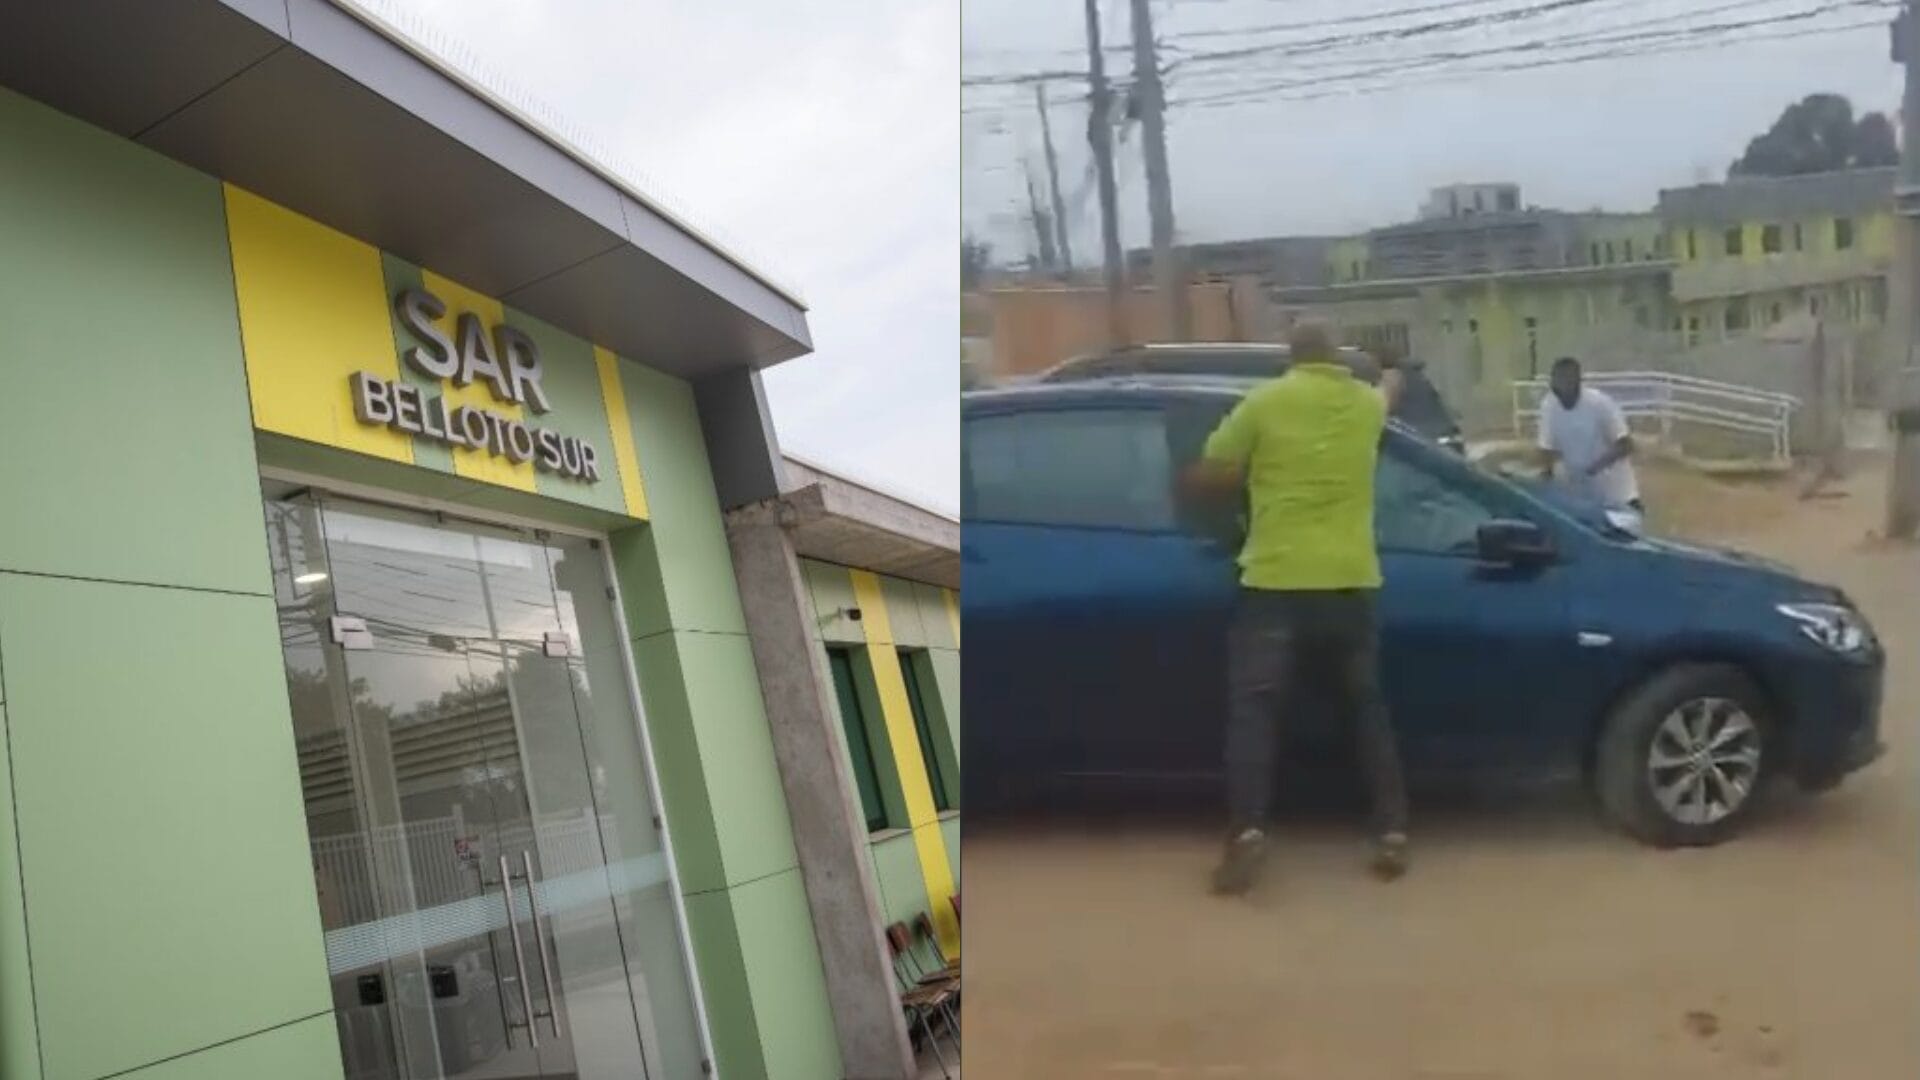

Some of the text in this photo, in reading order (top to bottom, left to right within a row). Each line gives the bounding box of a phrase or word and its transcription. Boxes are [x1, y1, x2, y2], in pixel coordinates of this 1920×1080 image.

[396, 289, 549, 413] SAR
[350, 371, 600, 482] BELLOTO SUR
